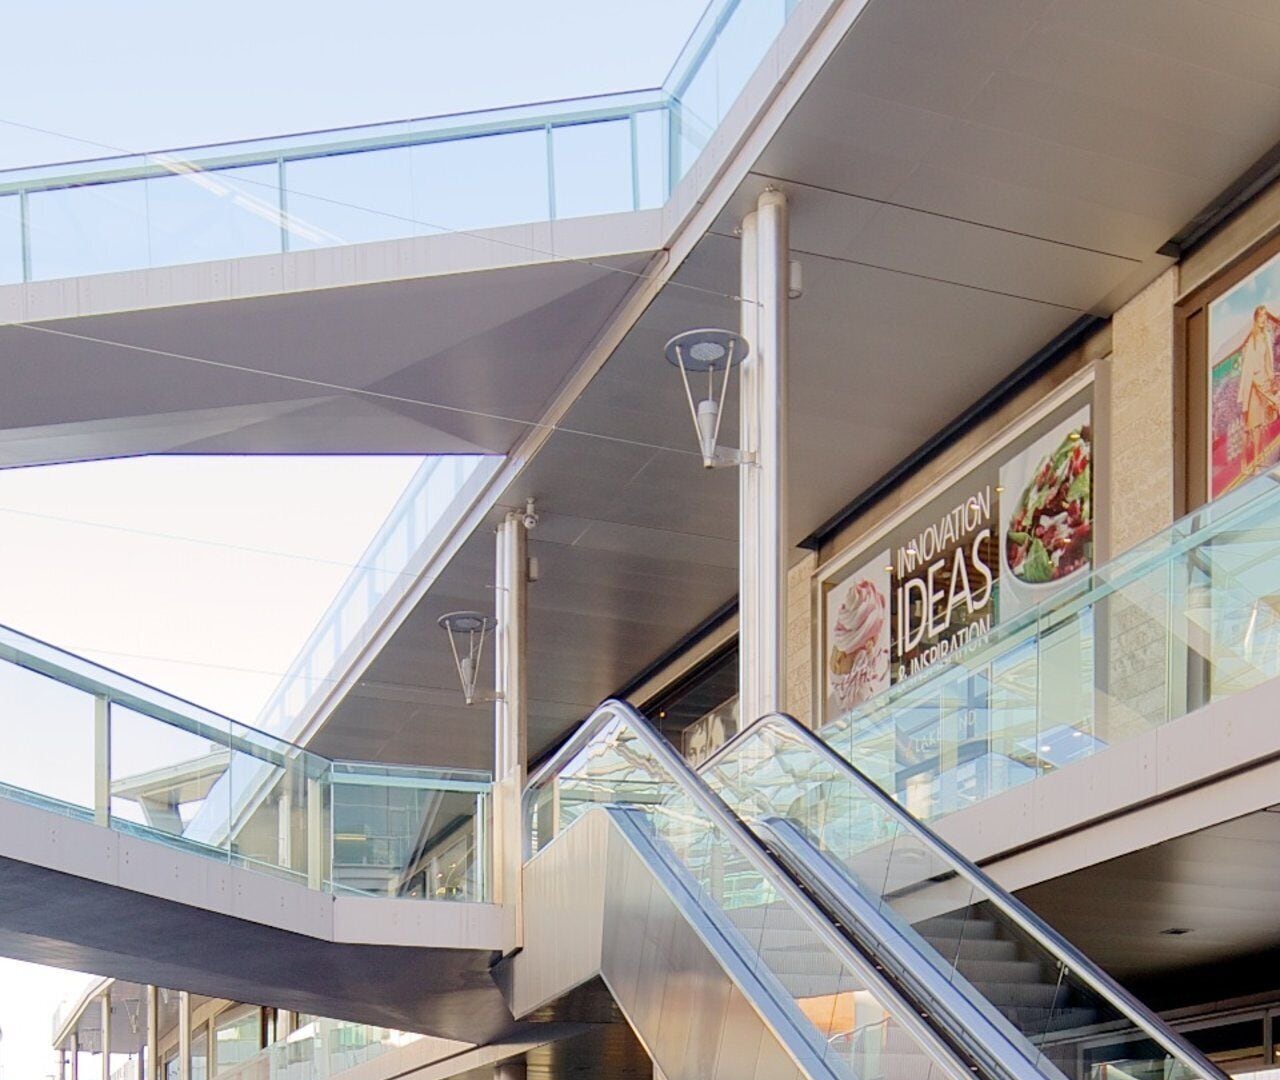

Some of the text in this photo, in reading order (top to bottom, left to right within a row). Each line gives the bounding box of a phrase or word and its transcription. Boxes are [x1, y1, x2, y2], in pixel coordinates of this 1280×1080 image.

[897, 486, 991, 580] INNOVATION
[897, 529, 992, 656] IDEAS
[910, 614, 991, 684] INSPIRATION
